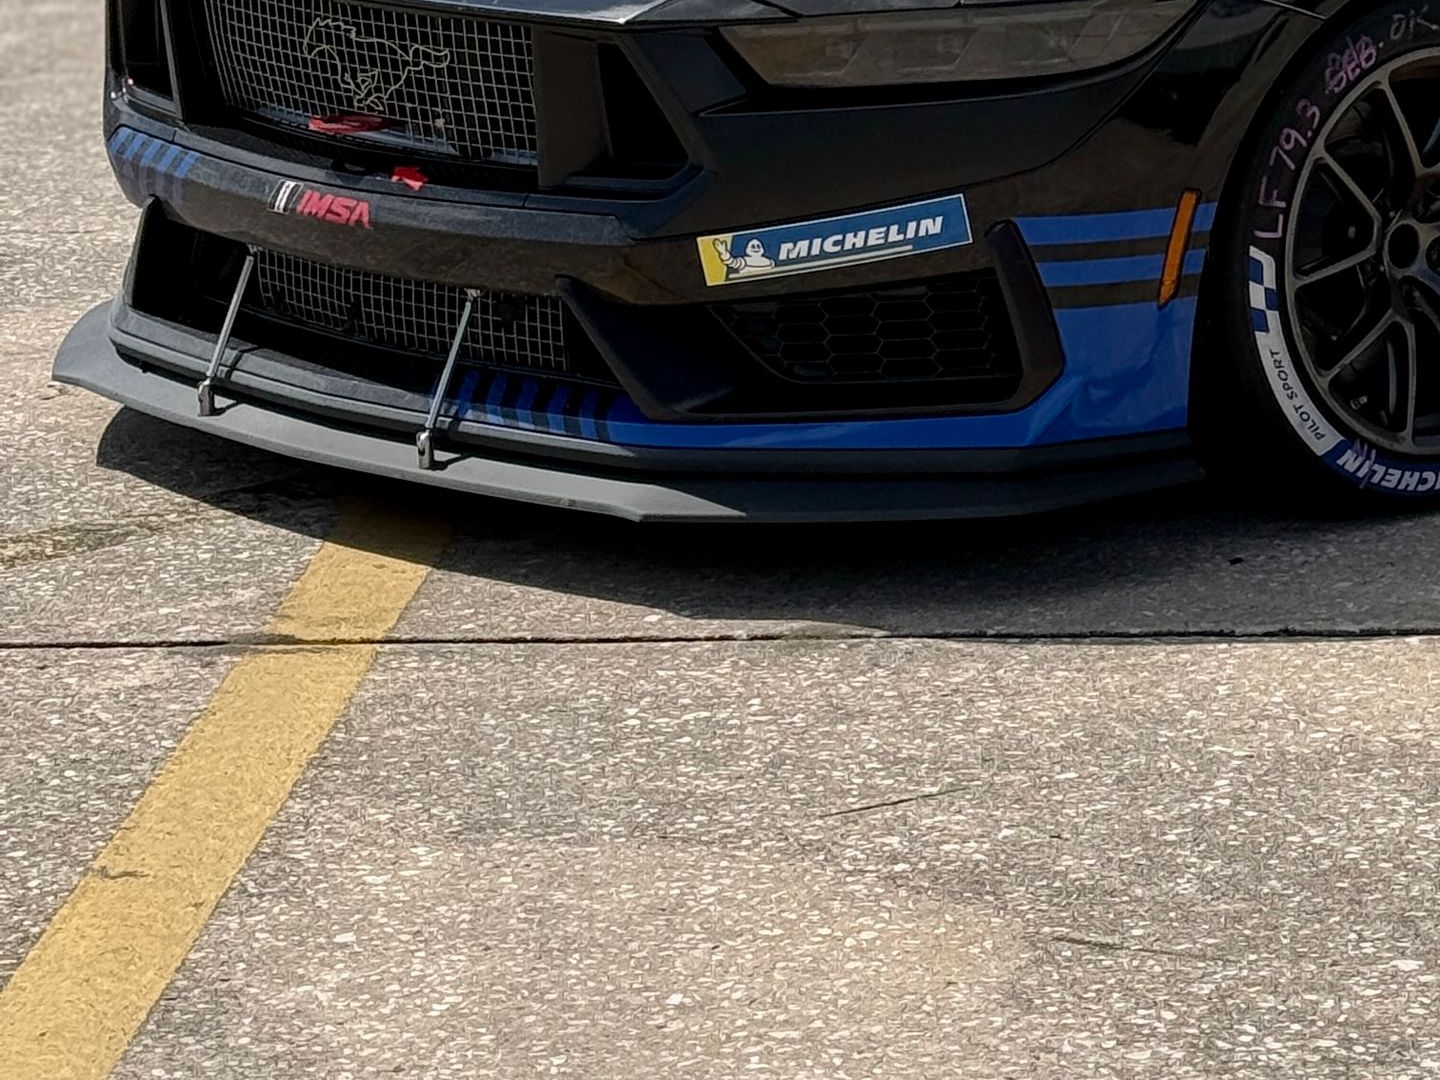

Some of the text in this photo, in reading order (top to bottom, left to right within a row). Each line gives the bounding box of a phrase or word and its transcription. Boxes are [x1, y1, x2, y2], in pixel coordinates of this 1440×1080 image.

[296, 189, 371, 229] IMSA
[779, 215, 944, 261] MICHELIN
[1269, 346, 1326, 442] PILOT SPORT
